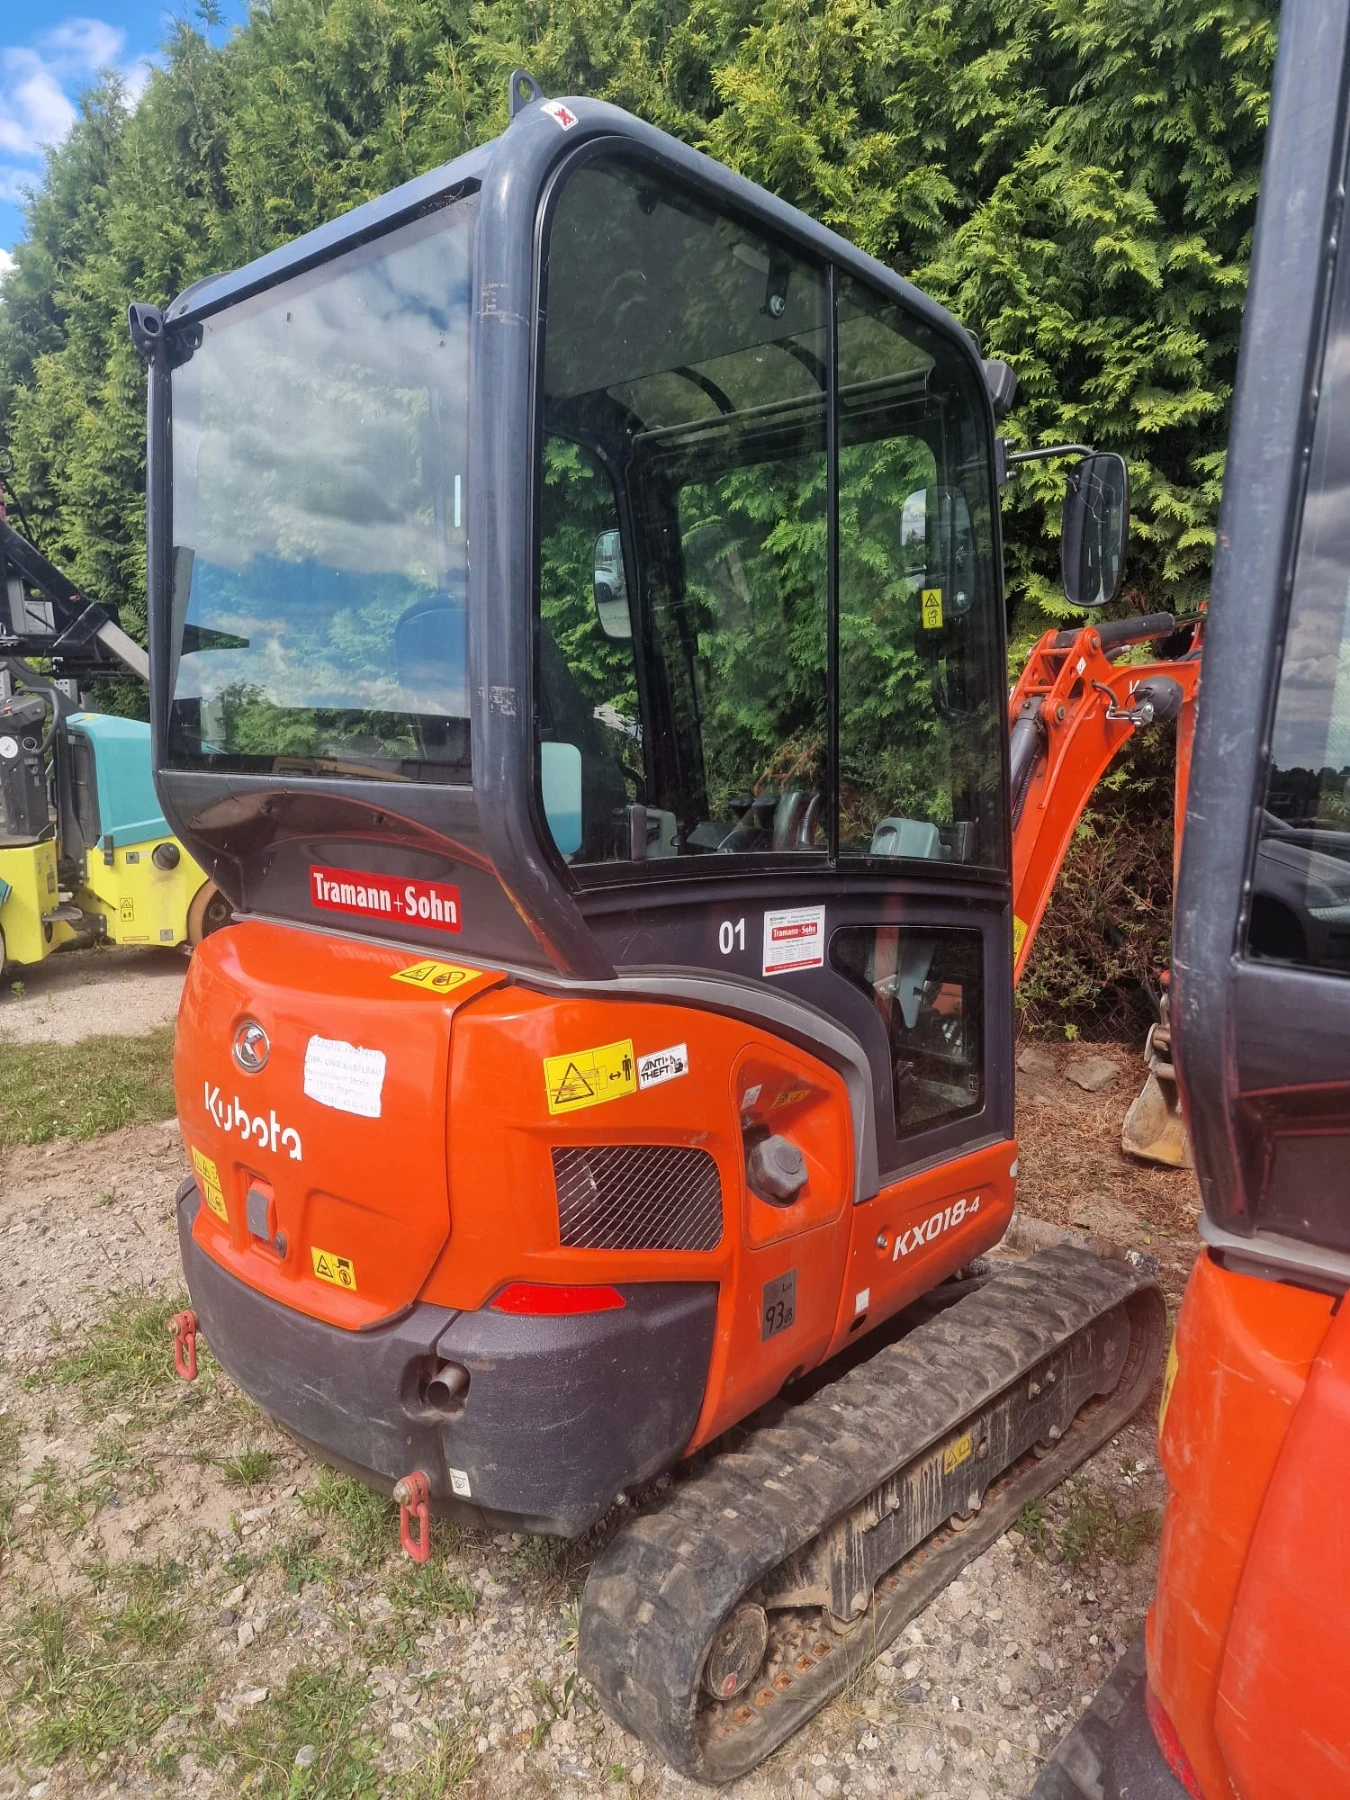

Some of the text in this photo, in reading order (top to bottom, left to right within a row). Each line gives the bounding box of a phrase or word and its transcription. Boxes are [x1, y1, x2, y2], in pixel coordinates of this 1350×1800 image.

[718, 918, 746, 955] 01
[641, 1066, 671, 1083] THEFT
[204, 1081, 303, 1161] Kubota
[892, 1195, 980, 1262] KX018-4
